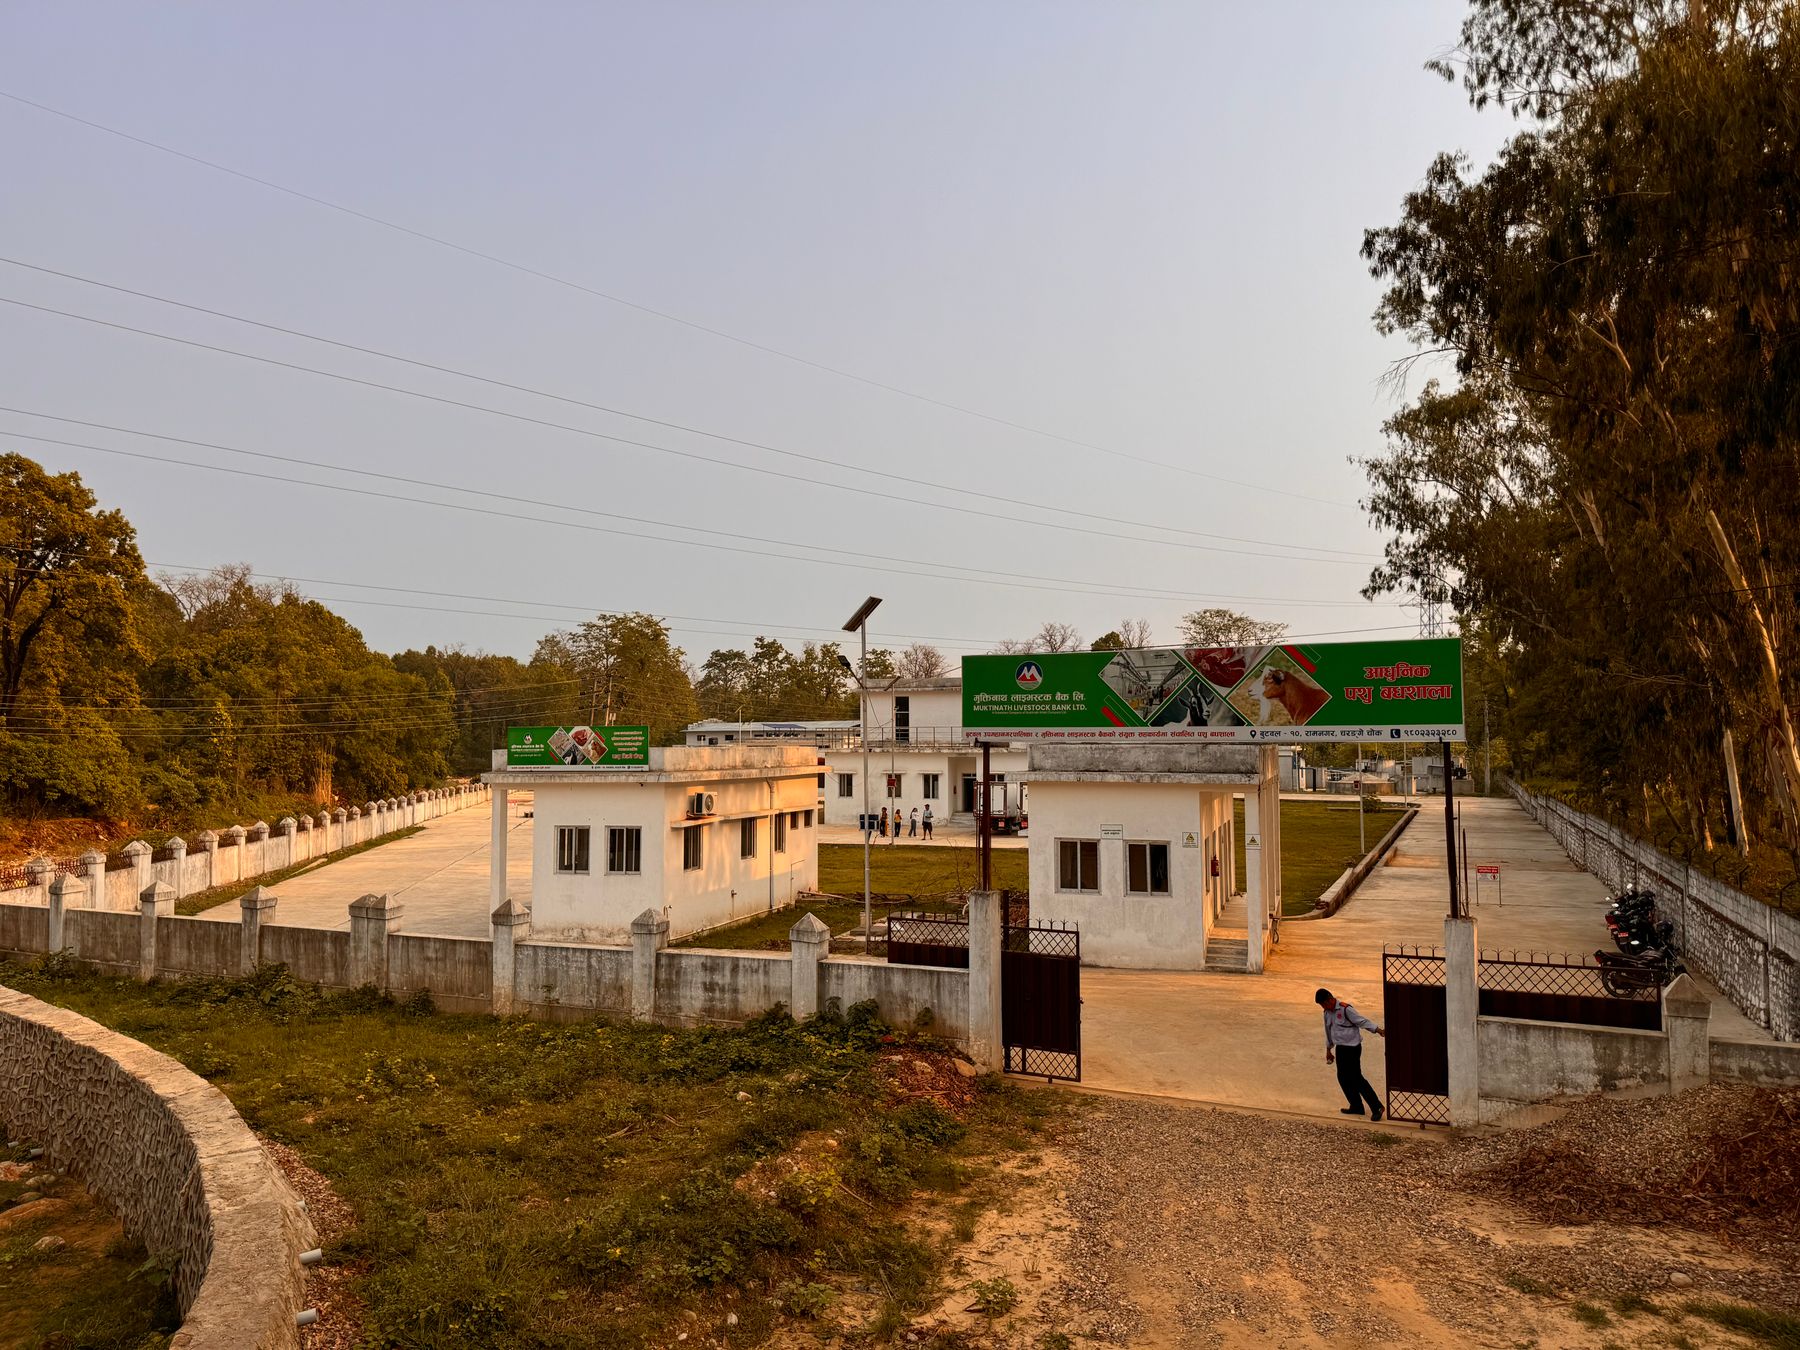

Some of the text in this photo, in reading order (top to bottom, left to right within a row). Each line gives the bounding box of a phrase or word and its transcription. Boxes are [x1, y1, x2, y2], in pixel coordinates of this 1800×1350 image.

[1362, 661, 1431, 682] आधुनिक
[973, 692, 1008, 703] मुक्तिनाथ
[1010, 692, 1052, 702] लाइभस्टक
[1072, 690, 1086, 701] लि.
[1343, 686, 1374, 705] पशु
[1051, 703, 1071, 711] BANK
[1072, 703, 1087, 711] LTD.
[1259, 730, 1281, 739] बुटवल
